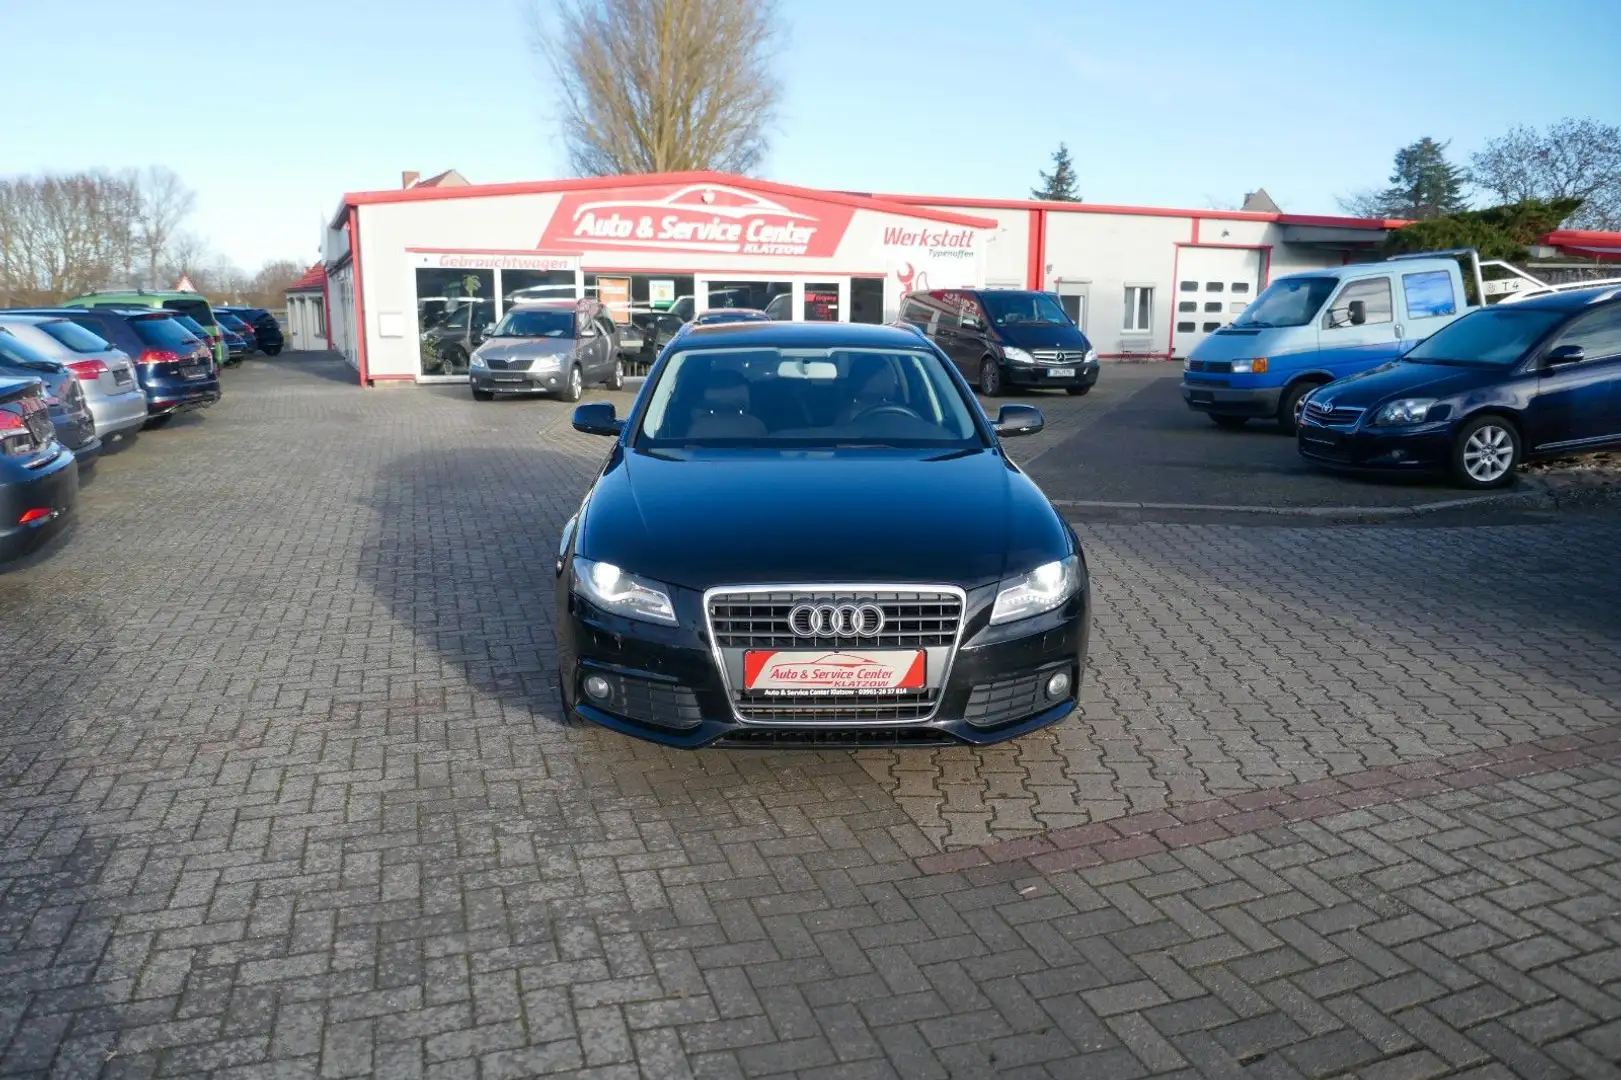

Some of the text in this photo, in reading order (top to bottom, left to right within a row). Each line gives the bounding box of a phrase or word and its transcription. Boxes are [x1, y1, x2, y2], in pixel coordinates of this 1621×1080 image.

[574, 213, 819, 244] Auto & Service Center
[883, 226, 975, 249] Werkstatt
[928, 248, 975, 259] Typenoffen
[438, 255, 568, 272] Gebrauchtwagen
[771, 668, 894, 679] Auto & Service Center
[764, 688, 780, 696] Auto
[787, 688, 809, 696] Service
